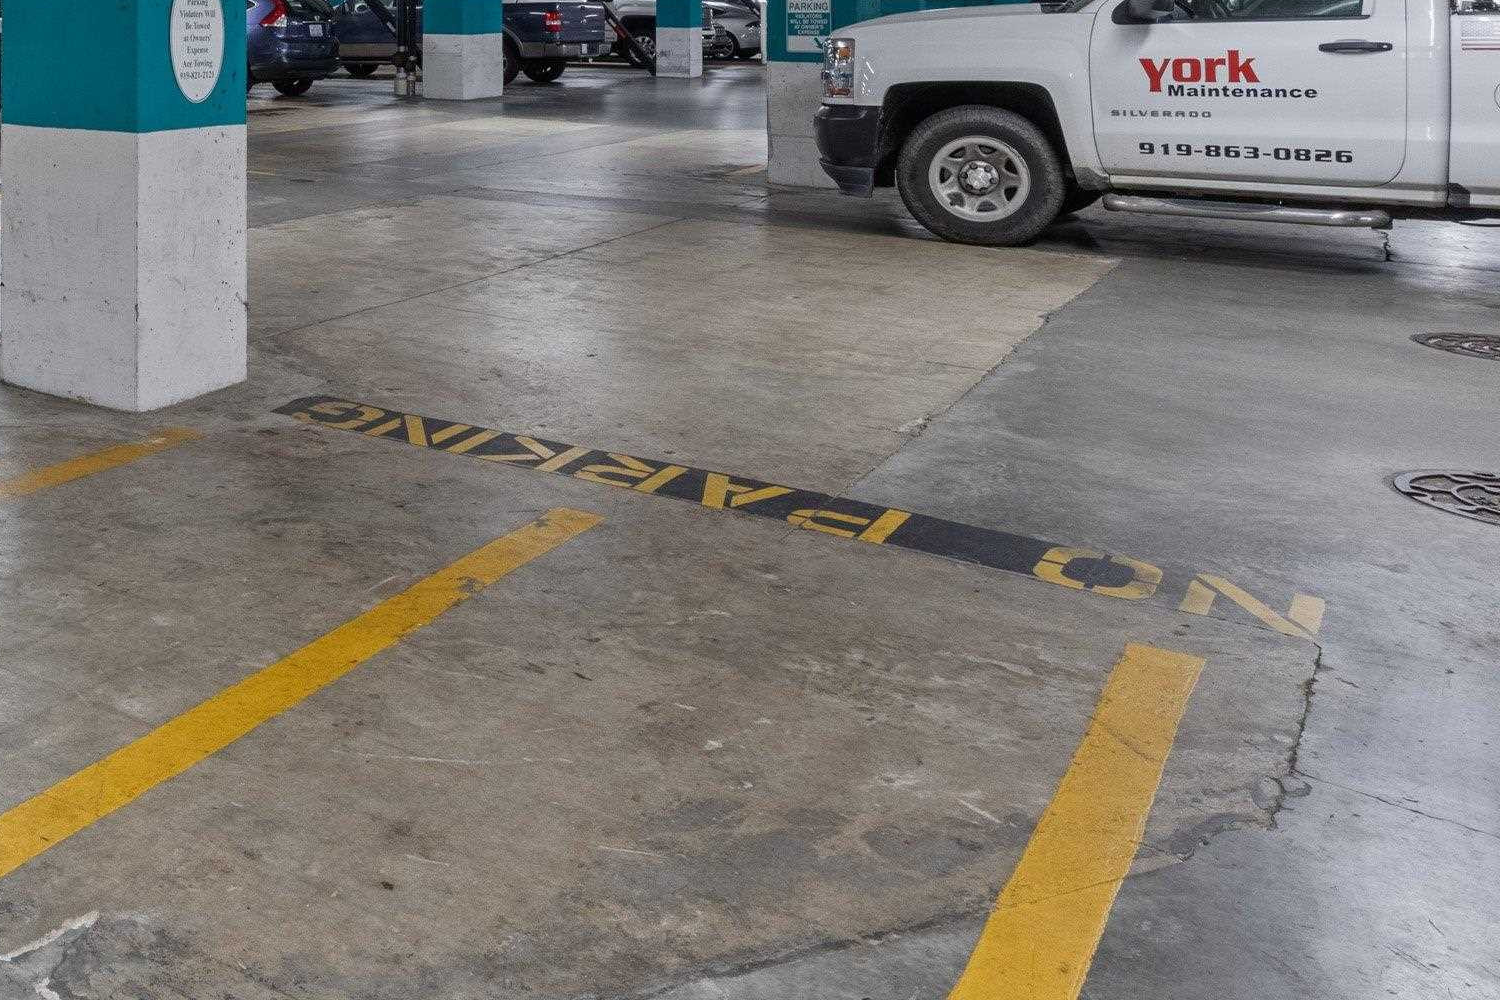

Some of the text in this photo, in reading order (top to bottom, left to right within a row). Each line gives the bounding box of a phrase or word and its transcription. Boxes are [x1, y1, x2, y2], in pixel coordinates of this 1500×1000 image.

[187, 0, 209, 7] Parking
[789, 2, 829, 11] PARKING
[192, 22, 211, 30] Towed
[187, 47, 209, 56] Expense
[193, 60, 213, 69] Towing
[1167, 84, 1318, 99] Maintenance
[1110, 109, 1212, 118] SILVERADO
[1138, 142, 1354, 164] 919-863-0826
[305, 399, 1326, 638] NO PARKING
